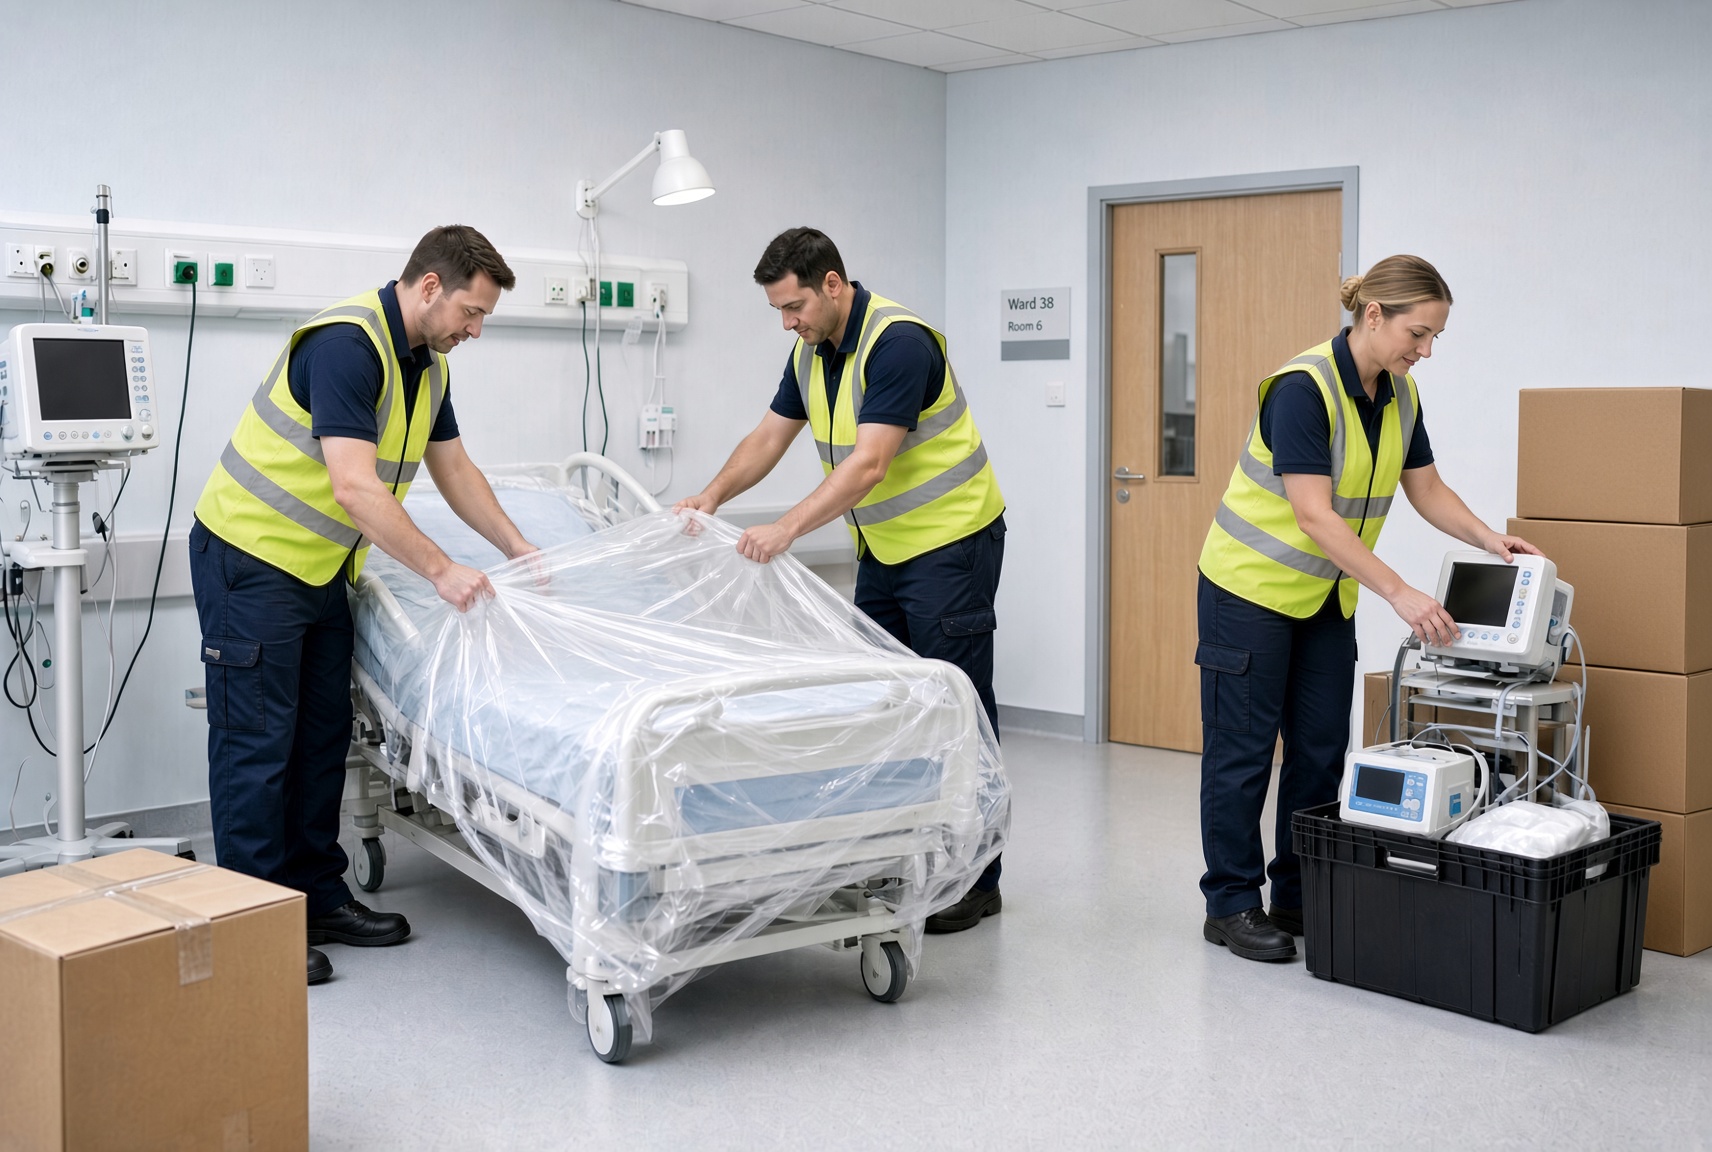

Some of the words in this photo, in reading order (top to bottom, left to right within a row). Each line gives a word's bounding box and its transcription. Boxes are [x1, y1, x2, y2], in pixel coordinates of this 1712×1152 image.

[1008, 297, 1036, 310] Ward
[1040, 297, 1054, 309] 38
[1008, 321, 1034, 332] Room
[1036, 320, 1043, 331] 6
